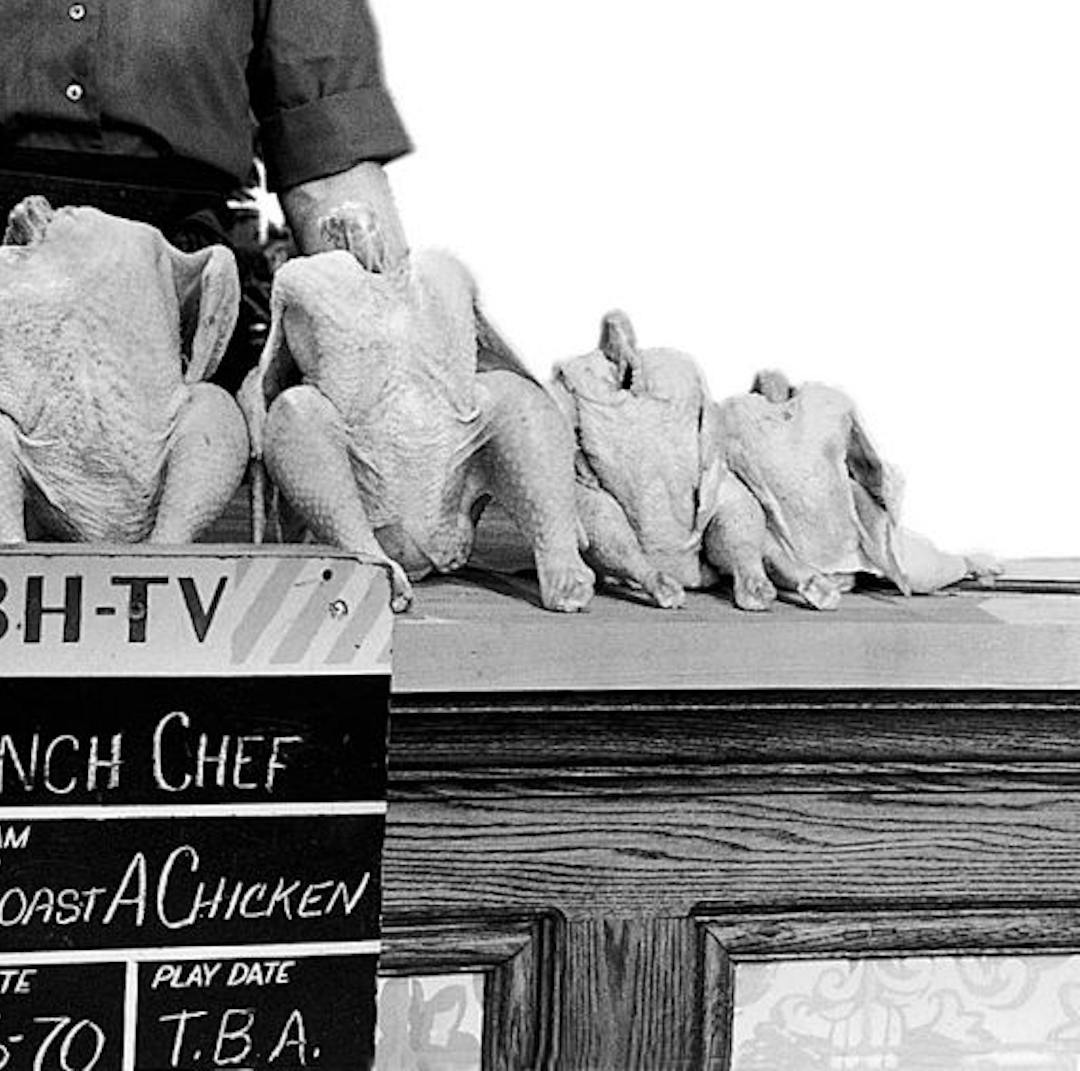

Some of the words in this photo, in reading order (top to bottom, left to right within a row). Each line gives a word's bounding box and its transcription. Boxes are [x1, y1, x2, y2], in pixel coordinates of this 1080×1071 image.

[152, 710, 304, 793] CHEF
[102, 851, 148, 926] A
[156, 844, 372, 929] CHICKEN
[150, 962, 222, 990] PLAY
[225, 960, 297, 987] DATE
